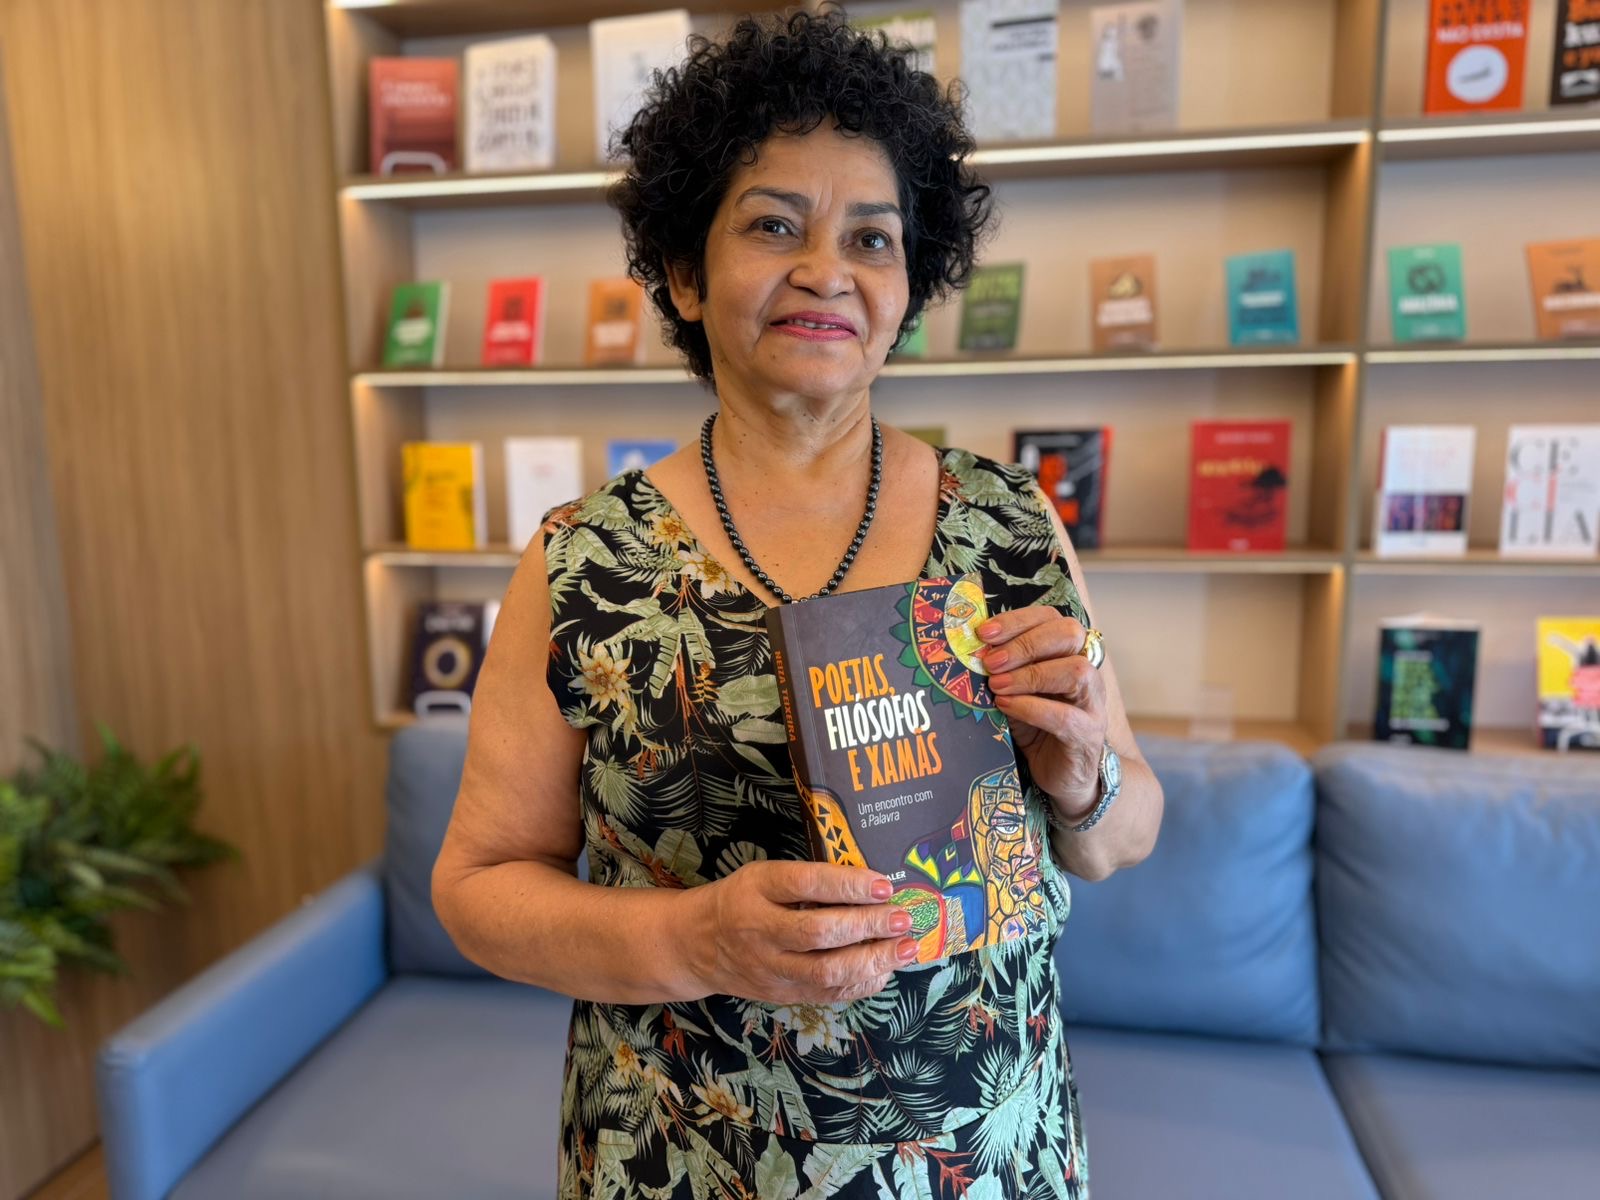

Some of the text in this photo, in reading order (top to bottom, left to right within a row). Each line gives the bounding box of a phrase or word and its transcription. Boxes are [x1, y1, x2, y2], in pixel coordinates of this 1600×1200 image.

[808, 653, 896, 708] POETAS,
[781, 688, 798, 742] TEIXEIRA
[824, 689, 931, 751] FILÓSOFOS
[847, 727, 943, 791] E XAMÃS
[857, 790, 934, 815] Um encontro com
[860, 811, 901, 829] a Palavra
[885, 870, 907, 881] ALER
